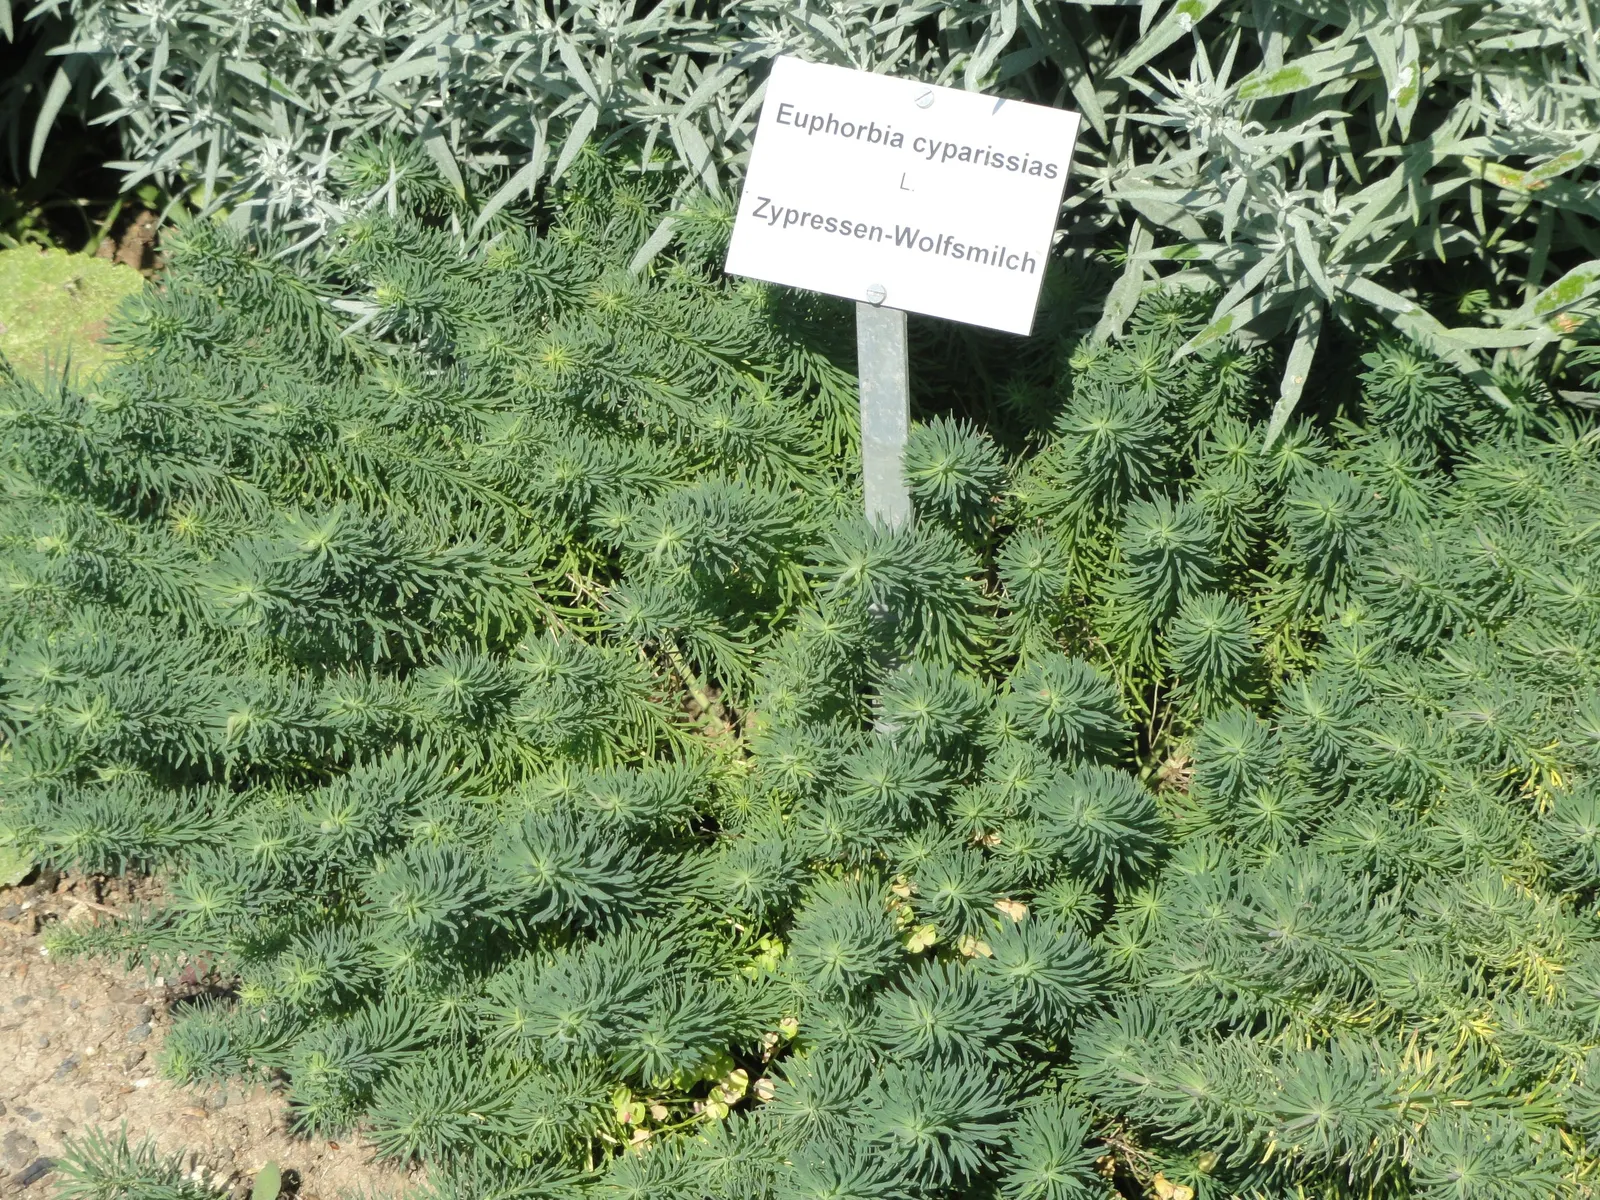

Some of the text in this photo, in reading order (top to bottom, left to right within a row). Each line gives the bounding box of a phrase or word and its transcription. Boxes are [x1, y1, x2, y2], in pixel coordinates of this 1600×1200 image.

[776, 102, 1058, 180] Euphorbia cyparissias
[752, 196, 1036, 275] Zypressen-Wolfsmilch
